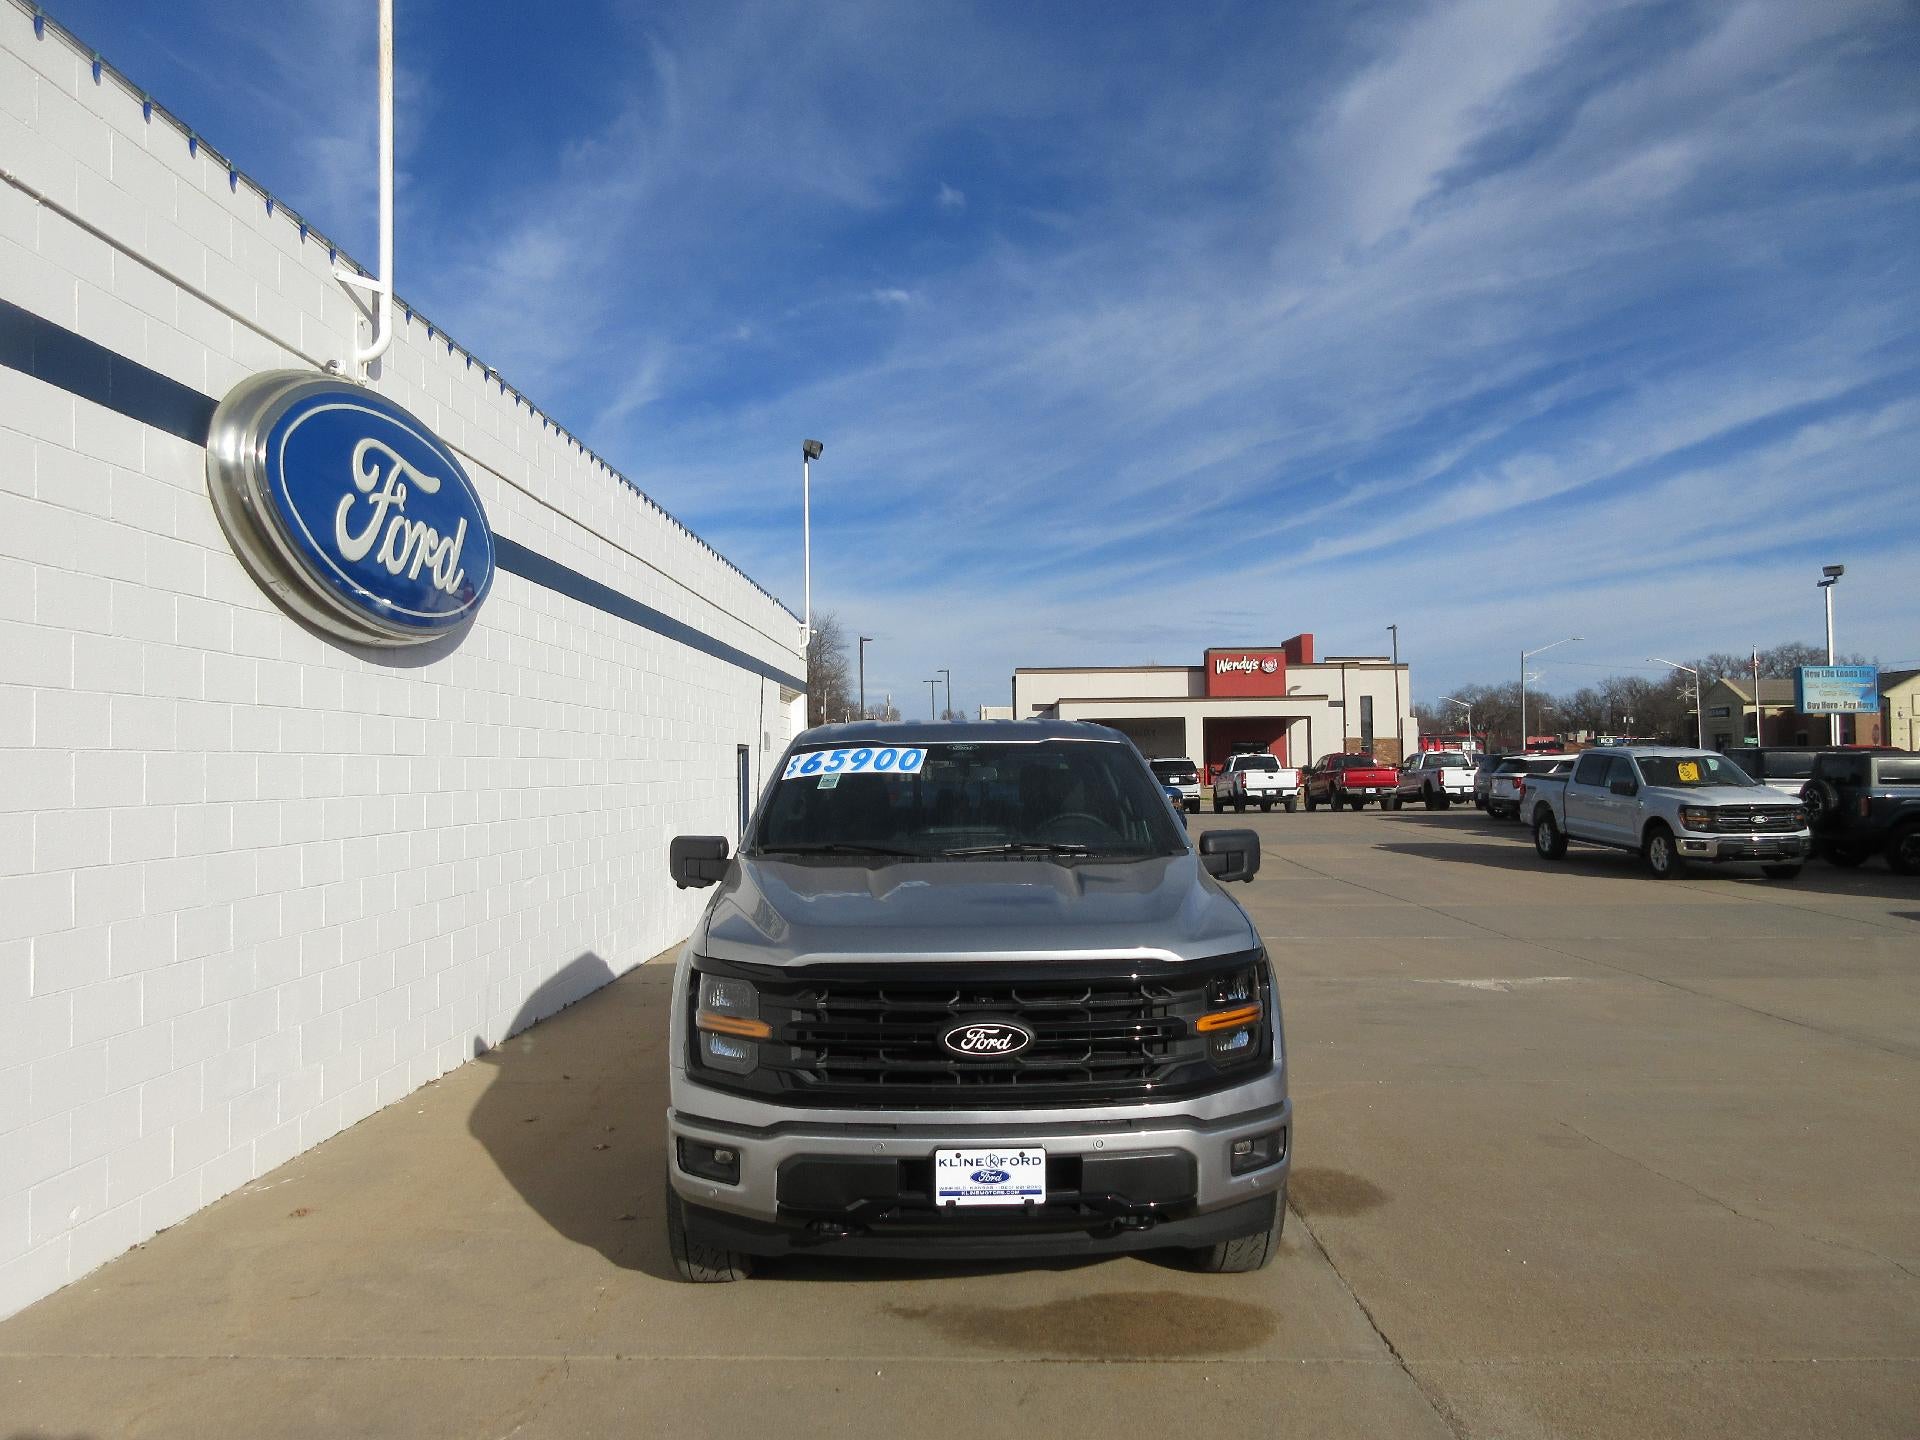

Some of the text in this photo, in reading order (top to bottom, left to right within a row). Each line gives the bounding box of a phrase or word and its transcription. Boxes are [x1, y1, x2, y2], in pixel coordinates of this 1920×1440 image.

[336, 437, 468, 595] Ford
[1216, 655, 1260, 674] Wendy's
[1804, 669, 1820, 678] New
[1821, 669, 1835, 678] Life
[1806, 701, 1820, 710] Buy
[1821, 701, 1838, 709] Here
[1843, 701, 1857, 710] Pay
[1857, 701, 1874, 709] Here
[961, 1028, 1012, 1050] Ford
[939, 1158, 984, 1168] KLINE
[1000, 1156, 1042, 1167] FORD
[978, 1169, 1003, 1183] Ford
